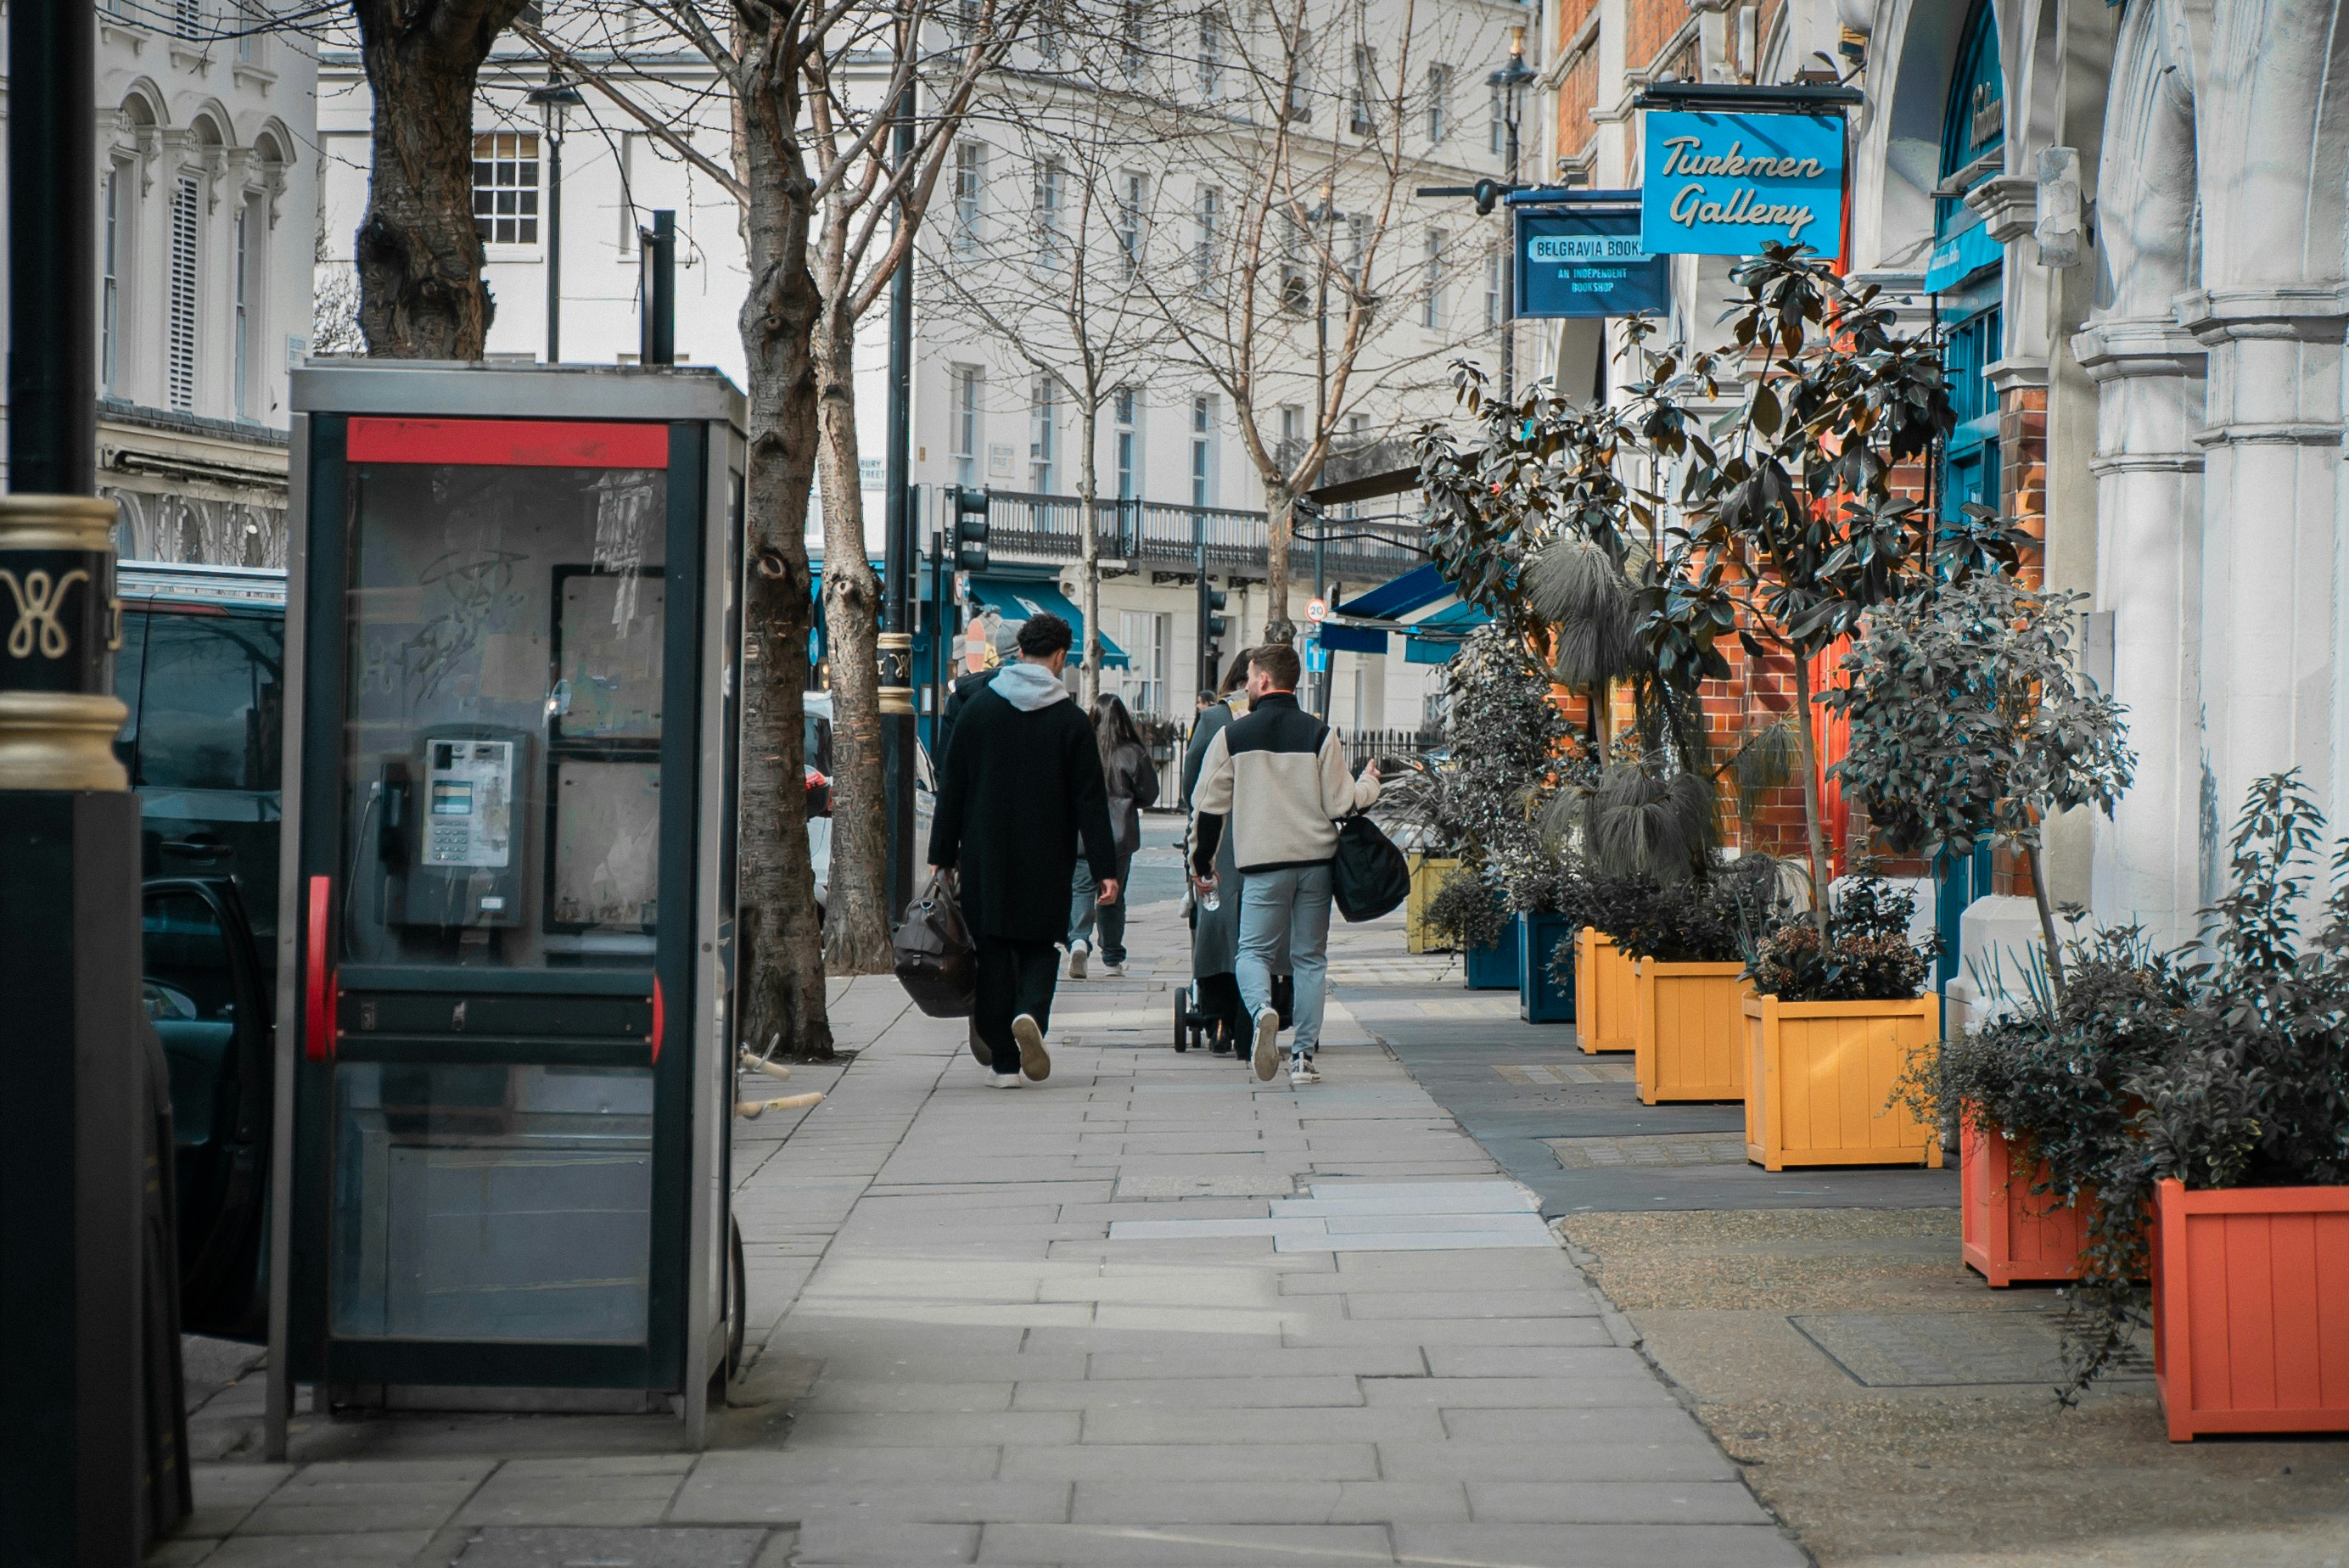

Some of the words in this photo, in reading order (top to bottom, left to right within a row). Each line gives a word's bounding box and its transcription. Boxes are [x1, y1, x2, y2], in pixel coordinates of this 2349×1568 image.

[1662, 135, 1825, 178] Turkmen
[1669, 182, 1814, 239] Gallery
[1537, 241, 1603, 256] BELGRAVIA
[1557, 268, 1570, 279] AN
[1573, 267, 1628, 279] INDEPENDENT
[1571, 282, 1614, 293] BOOKSHOP
[859, 459, 882, 468] BURY
[860, 469, 884, 479] TREET
[1309, 606, 1324, 616] 20
